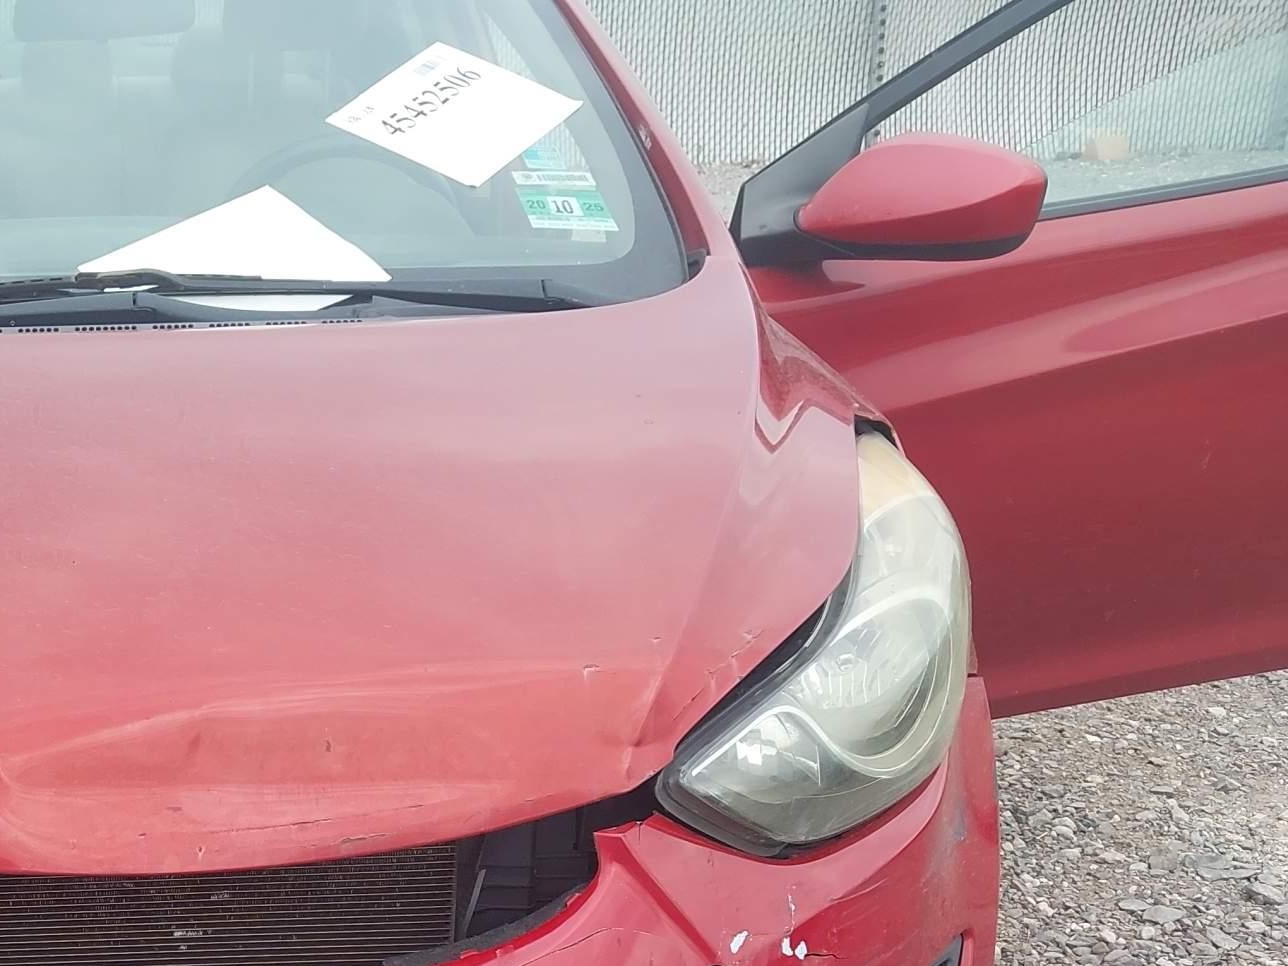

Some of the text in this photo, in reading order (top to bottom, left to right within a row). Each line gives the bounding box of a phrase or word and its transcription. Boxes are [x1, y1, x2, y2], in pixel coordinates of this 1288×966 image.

[381, 66, 481, 135] 45452506
[526, 199, 546, 209] 20
[552, 199, 574, 214] 10
[583, 202, 604, 212] 25
